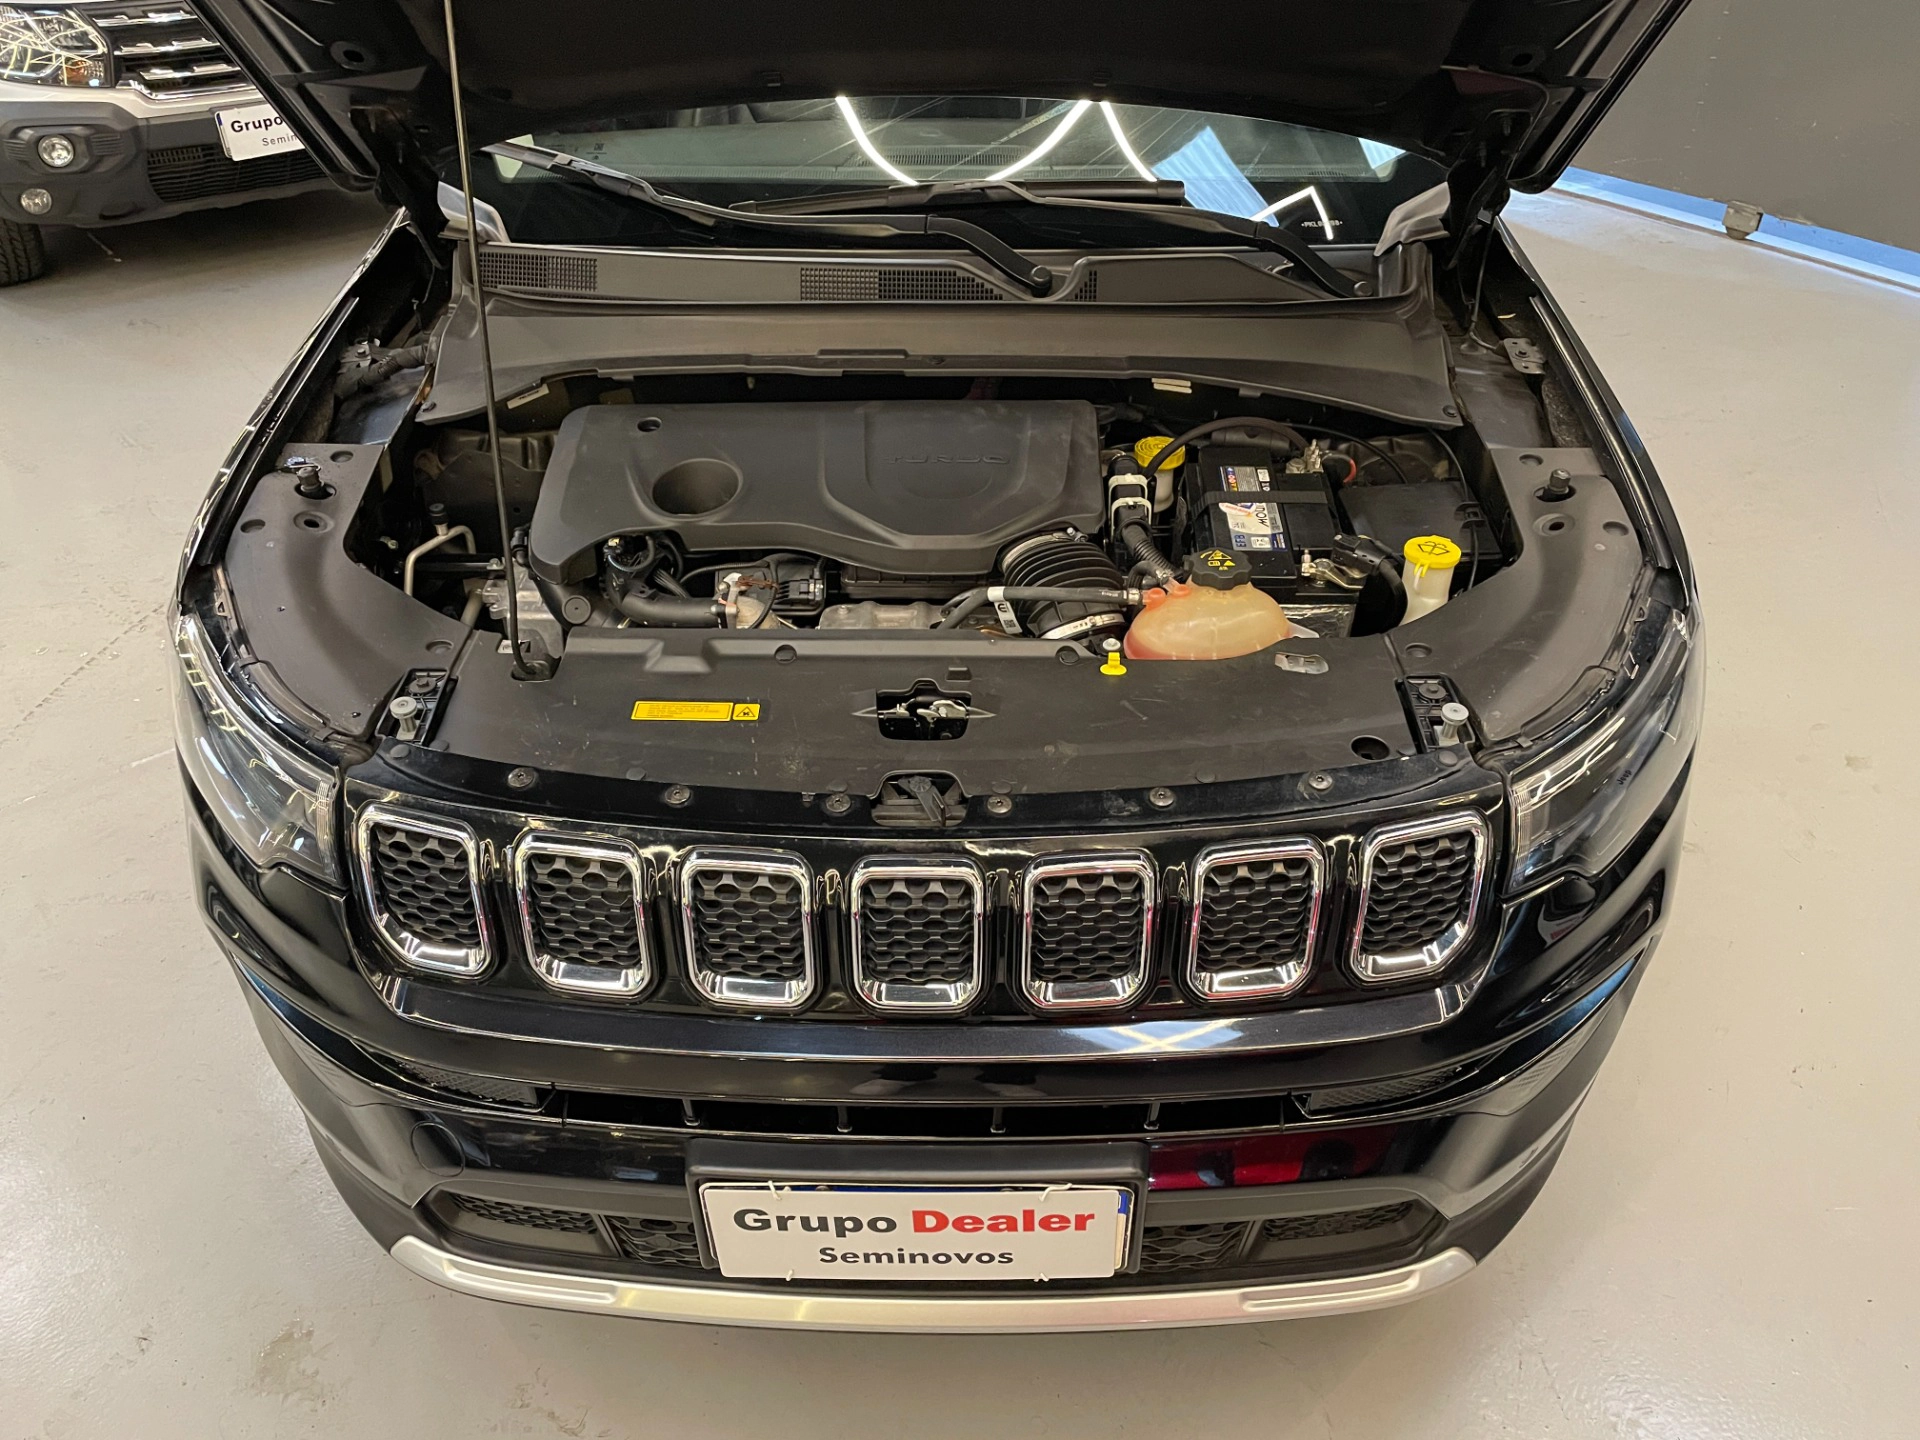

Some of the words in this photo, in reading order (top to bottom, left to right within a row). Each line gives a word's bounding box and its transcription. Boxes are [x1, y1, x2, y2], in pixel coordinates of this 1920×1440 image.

[231, 116, 284, 133] Grupo
[262, 134, 297, 146] Semin
[1255, 503, 1269, 528] MOU
[734, 1209, 896, 1237] Grupo
[913, 1210, 1094, 1232] Dealer
[820, 1248, 1013, 1264] Seminovos
